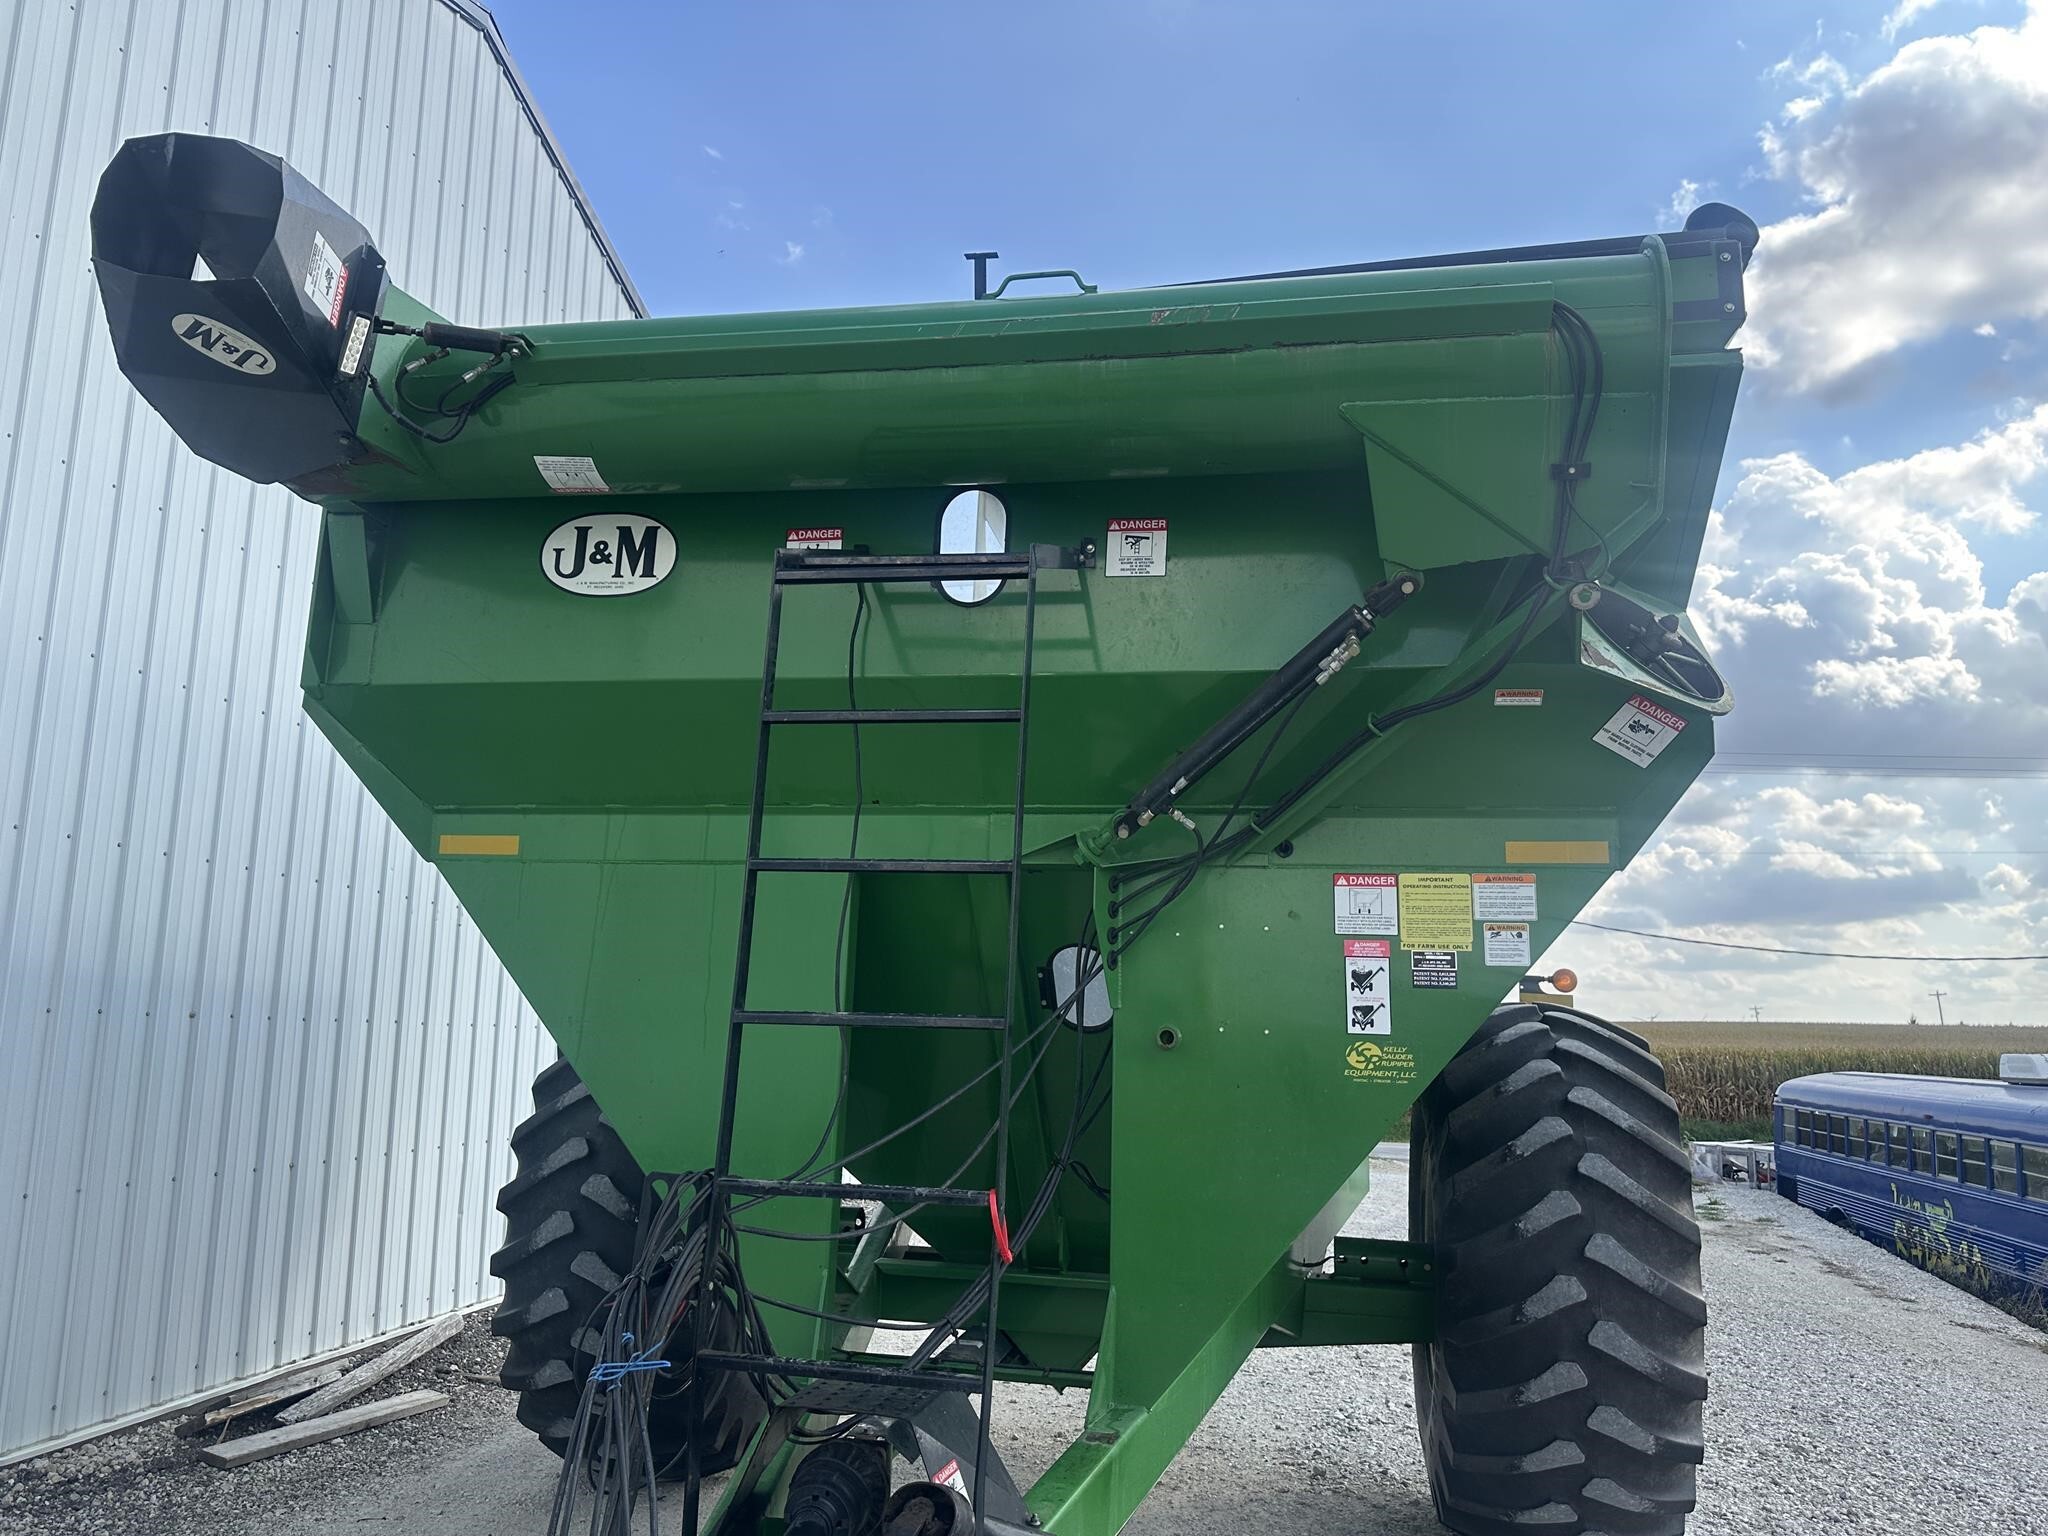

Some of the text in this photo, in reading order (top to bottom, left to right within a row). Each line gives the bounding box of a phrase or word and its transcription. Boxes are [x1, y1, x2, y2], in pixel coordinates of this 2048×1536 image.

[331, 278, 346, 328] DANGER
[179, 317, 269, 370] J&M
[1120, 519, 1167, 529] DANGER
[798, 529, 842, 539] DANGER
[552, 526, 661, 579] J&M
[1640, 701, 1686, 730] DANGER
[1349, 876, 1396, 886] DANGER
[1381, 1060, 1415, 1068] RUPIPER
[1344, 1069, 1399, 1078] EQUIPMENT,
